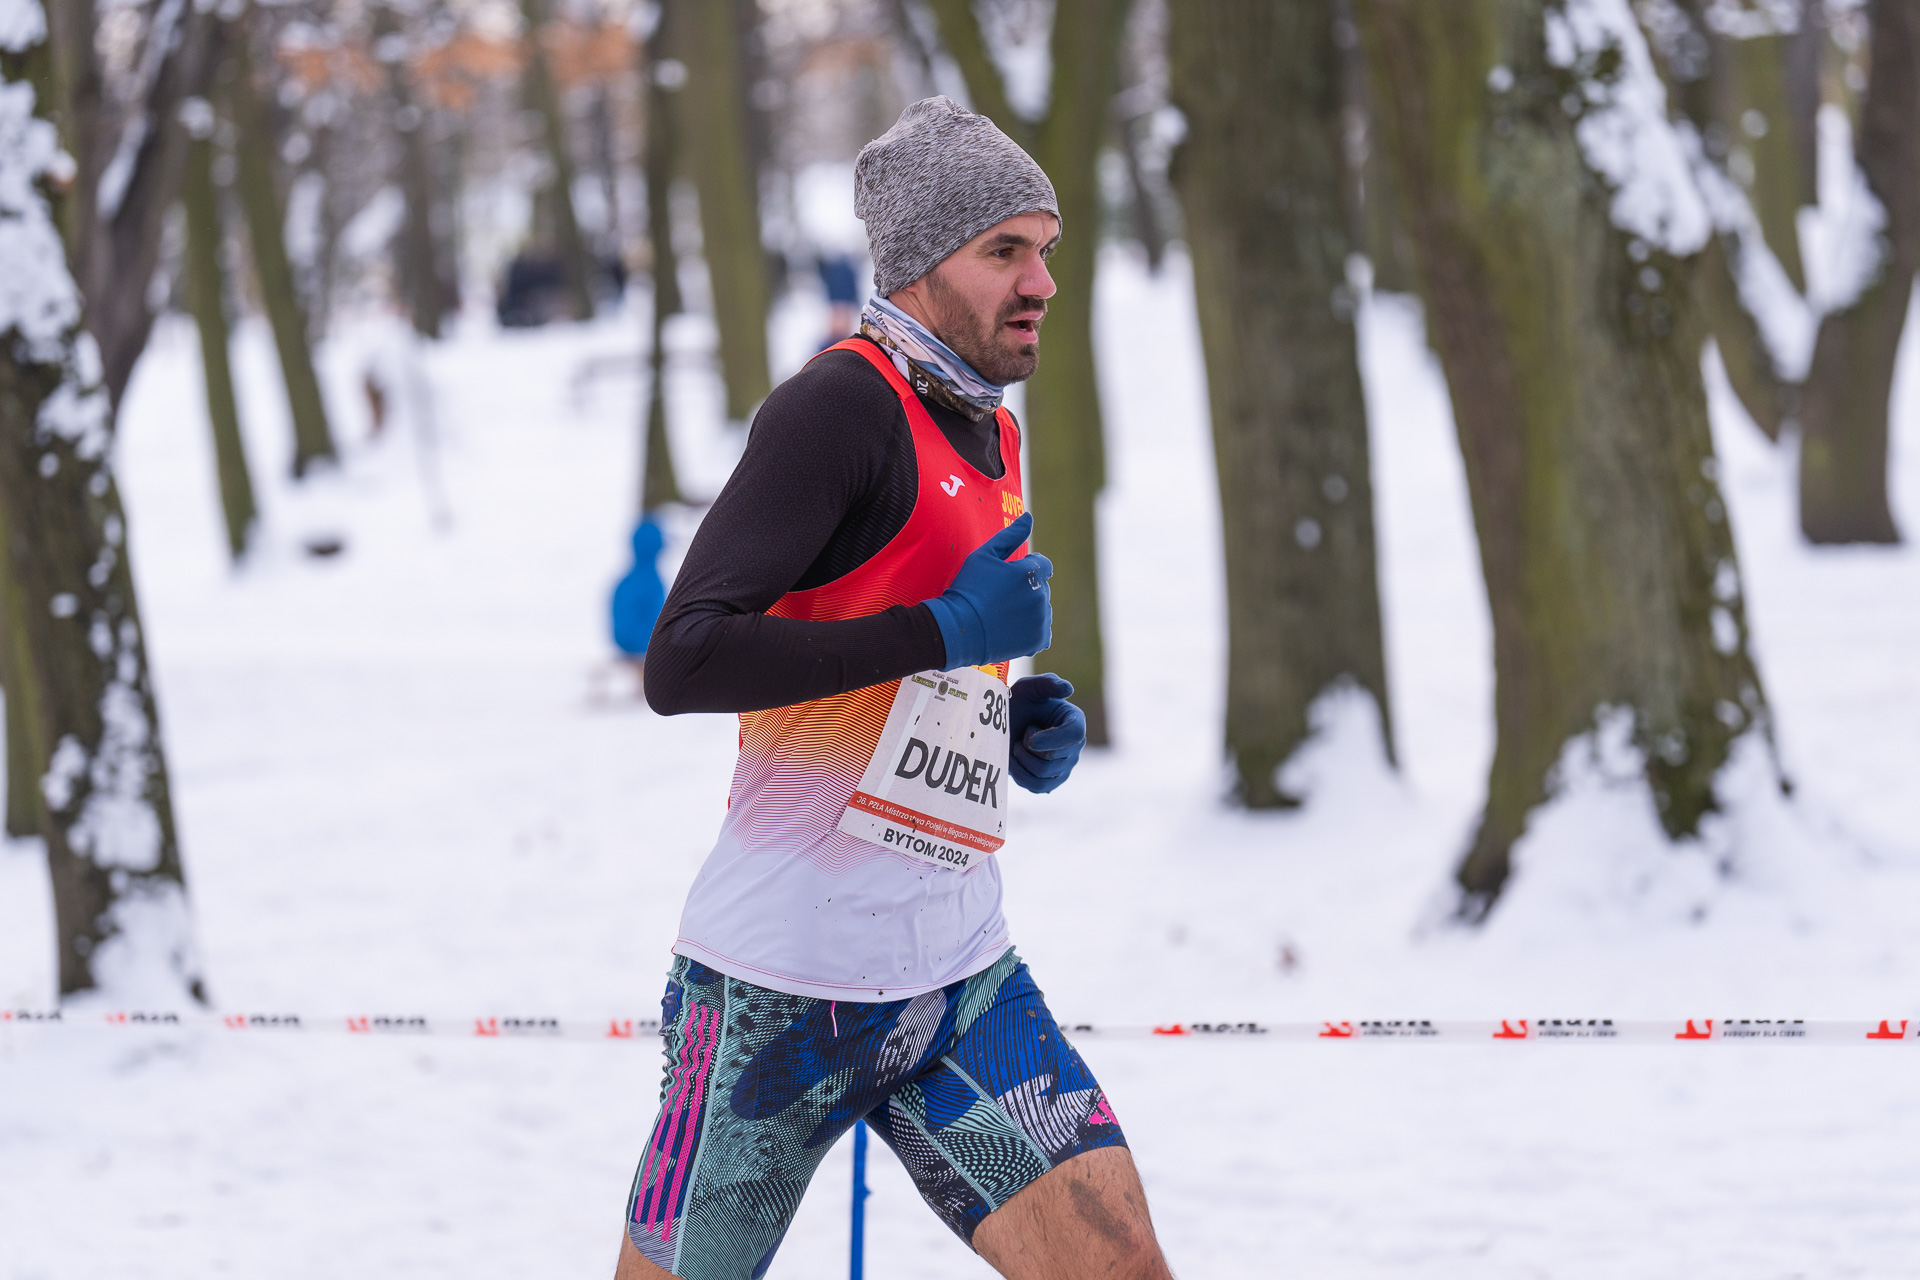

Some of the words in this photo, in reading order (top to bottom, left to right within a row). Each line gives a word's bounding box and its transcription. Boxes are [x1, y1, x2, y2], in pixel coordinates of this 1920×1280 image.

[1001, 490, 1026, 517] JUVE
[979, 689, 1007, 735] 383
[894, 737, 1001, 809] DUDEK
[856, 796, 867, 806] 36.
[925, 820, 943, 832] Polski
[883, 828, 938, 857] BYTOM
[938, 846, 970, 867] 2024
